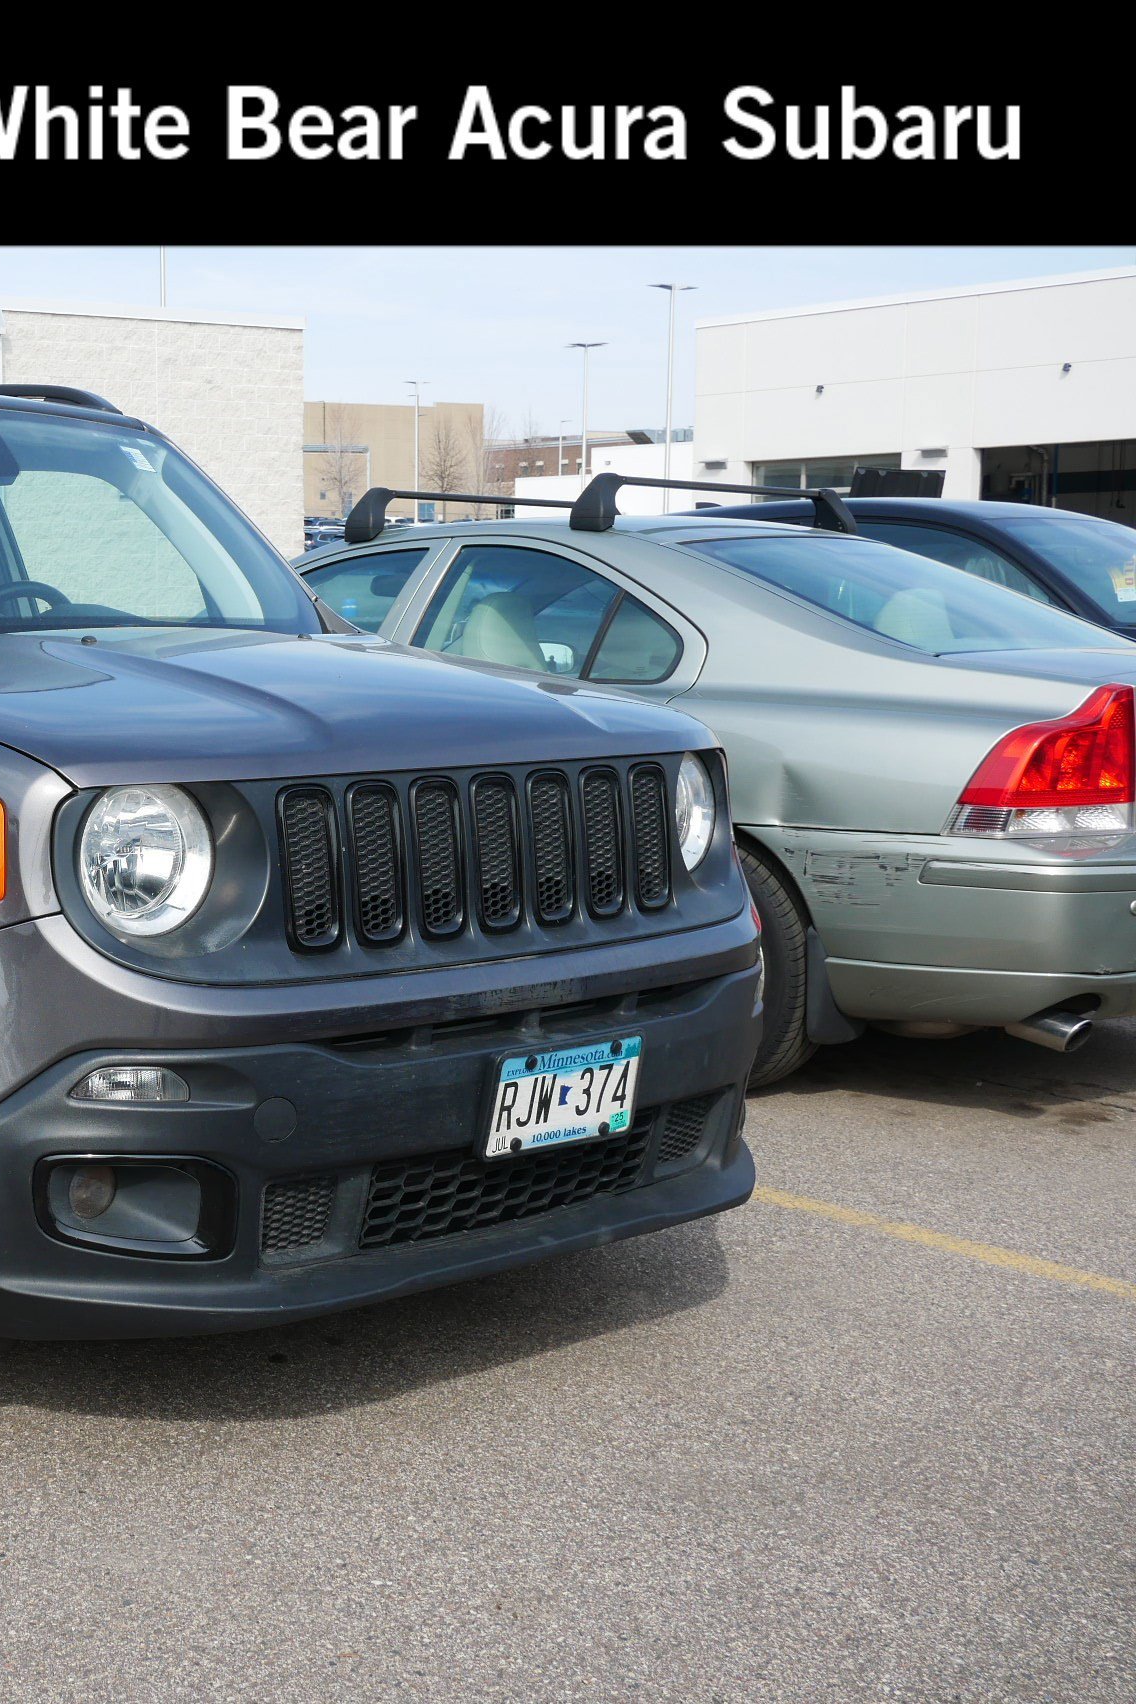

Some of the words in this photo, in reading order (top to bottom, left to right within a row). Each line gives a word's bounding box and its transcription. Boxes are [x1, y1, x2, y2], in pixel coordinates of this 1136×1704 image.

[496, 1073, 558, 1133] RJW
[575, 1060, 631, 1116] 374
[614, 1111, 624, 1123] 25
[531, 1129, 561, 1143] 10,000
[564, 1126, 587, 1138] lakes
[492, 1136, 509, 1153] JUL
